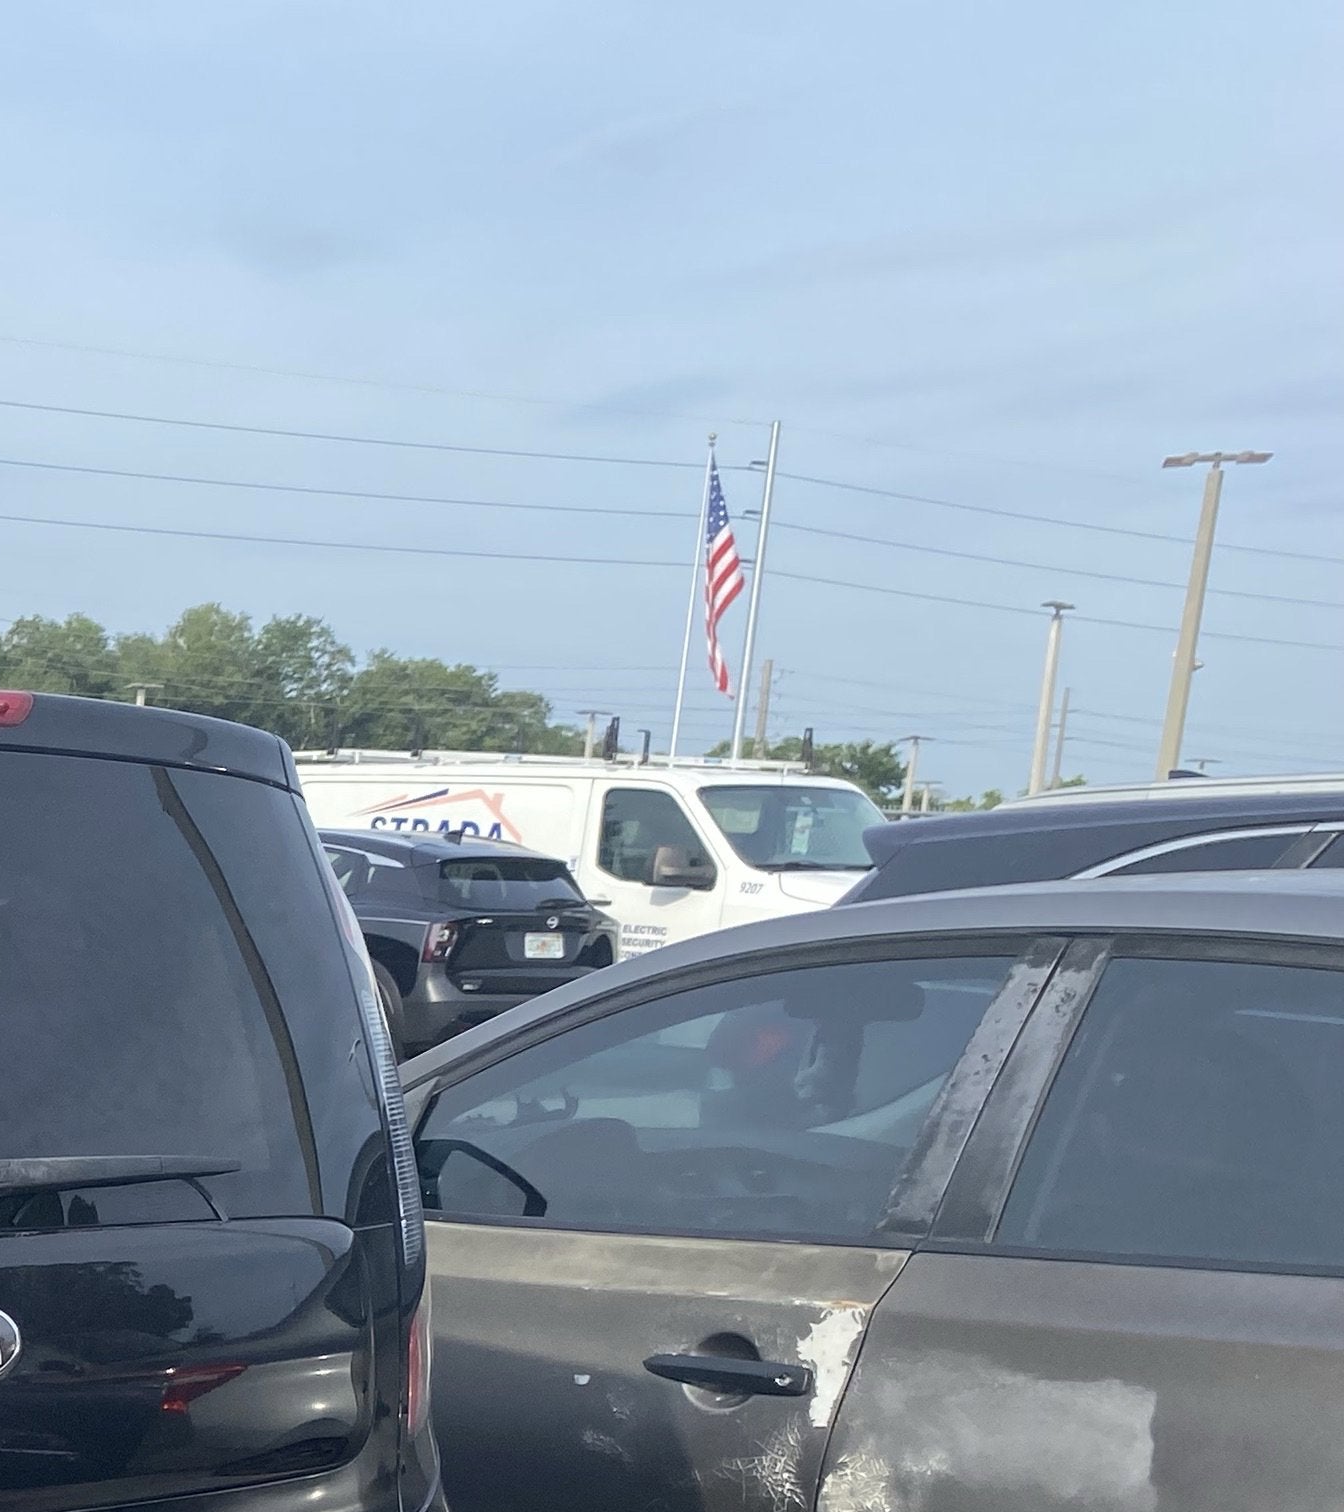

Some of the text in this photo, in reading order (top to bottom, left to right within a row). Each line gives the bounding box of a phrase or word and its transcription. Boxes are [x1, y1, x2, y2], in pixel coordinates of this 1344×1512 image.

[739, 881, 764, 895] 9207
[622, 924, 667, 937] ELECTRIC
[621, 937, 666, 949] SECURITY
